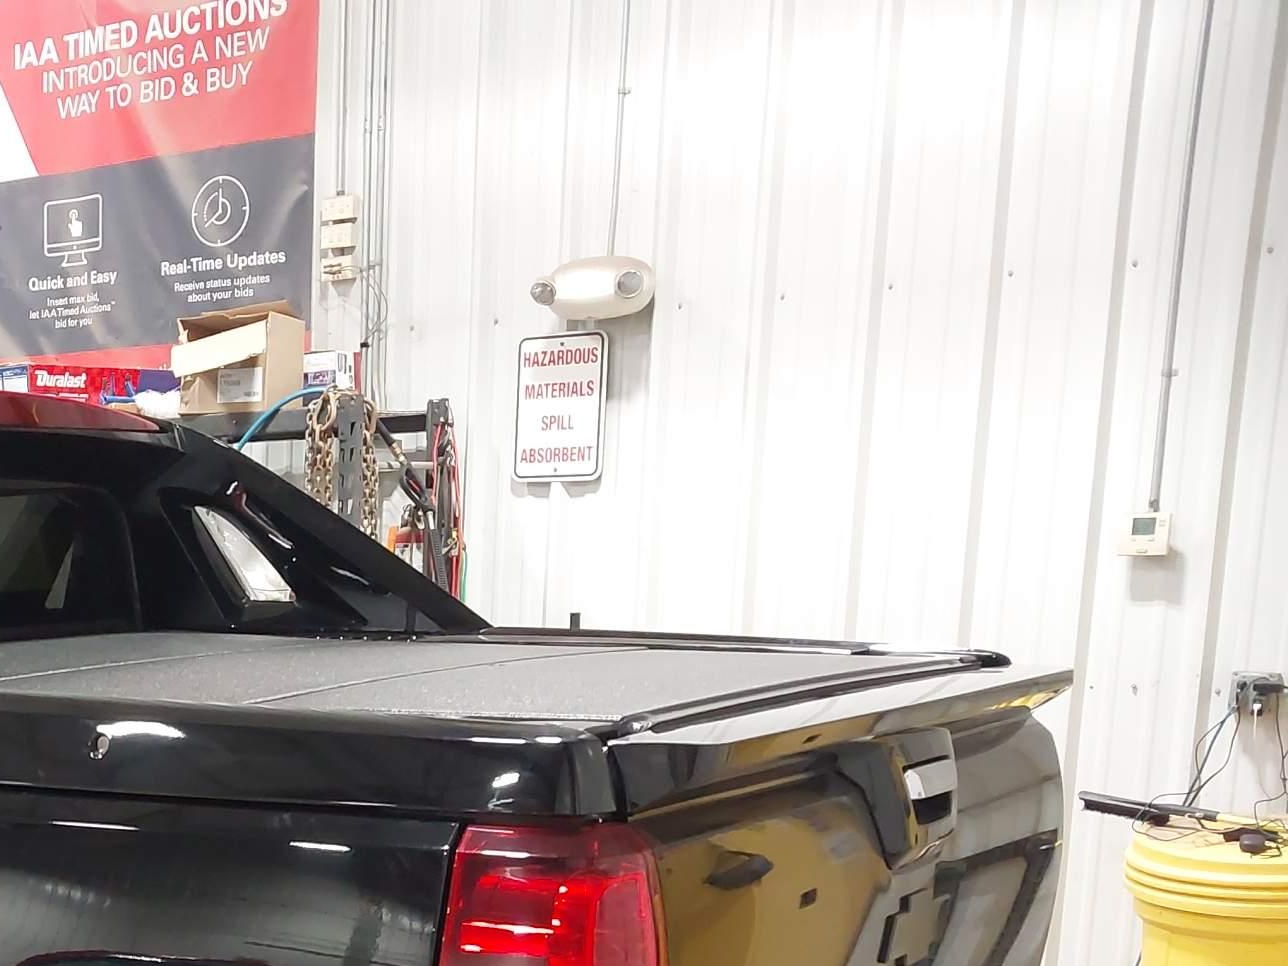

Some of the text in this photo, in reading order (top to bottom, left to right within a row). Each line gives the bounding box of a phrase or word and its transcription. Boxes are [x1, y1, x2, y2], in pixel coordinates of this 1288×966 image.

[13, 0, 288, 70] IAA TIMED AUCTIONS
[41, 26, 270, 94] INTRODUCING A NEW
[56, 60, 253, 120] WAY TO BID & BUY
[160, 251, 287, 276] Real-Time Updates
[28, 270, 118, 291] Quick and Easy
[174, 274, 271, 292] Receive status updates
[47, 296, 68, 307] Insert
[69, 296, 85, 305] max
[187, 286, 254, 303] about your bids
[29, 310, 40, 319] let
[41, 308, 57, 318] IAA
[55, 317, 93, 329] bid for you
[523, 346, 599, 368] HAZARDOUS
[34, 369, 87, 389] Duralast
[524, 380, 595, 401] MATERIALS
[541, 414, 574, 431] SPILL
[520, 446, 594, 464] ABSORBENT
